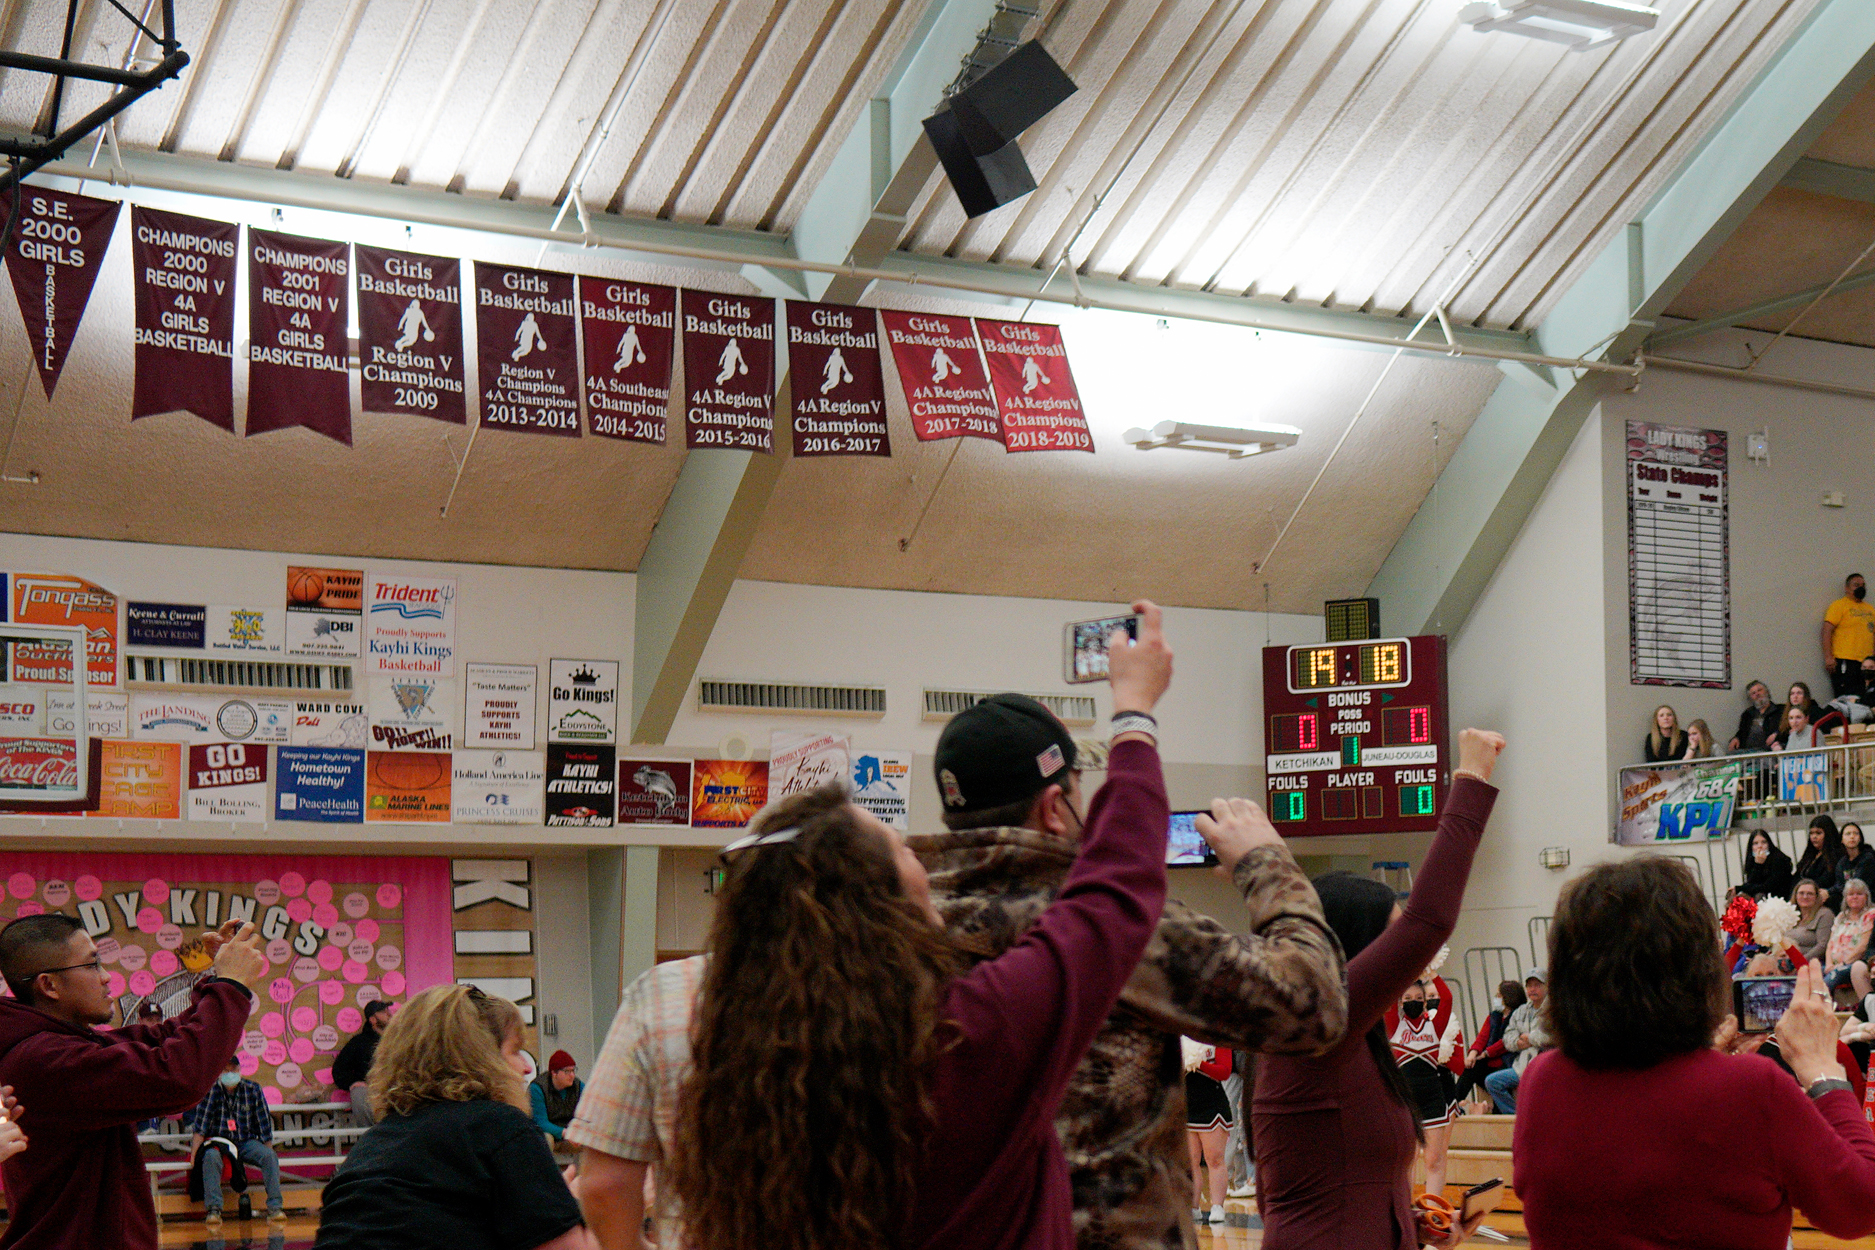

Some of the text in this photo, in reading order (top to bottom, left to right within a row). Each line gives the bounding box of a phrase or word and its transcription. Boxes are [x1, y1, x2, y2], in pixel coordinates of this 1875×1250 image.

[32, 197, 74, 221] S.E.
[22, 218, 81, 244] 2000
[138, 226, 234, 258] CHAMPIONS
[19, 240, 85, 267] GIRLS
[164, 251, 207, 273] 2000
[254, 247, 347, 275] CHAMPIONS
[385, 258, 433, 280] Girls
[146, 268, 225, 295] REGION V
[282, 272, 320, 291] 2001
[359, 273, 458, 304] Basketball
[503, 272, 549, 293] Girls
[174, 295, 196, 312] 4A
[263, 287, 338, 312] REGION V
[480, 288, 574, 317] Basketball
[45, 264, 55, 370] BASKETBALL
[161, 312, 209, 333] GIRLS
[290, 312, 311, 329] 4A
[812, 309, 853, 329] Girls
[278, 329, 324, 350] GIRLS
[790, 326, 877, 349] Basketball
[1001, 325, 1040, 341] Girls
[135, 328, 233, 358] BASKETBALL
[984, 339, 1065, 357] Basketball
[251, 346, 348, 373] BASKETBALL
[372, 346, 452, 372] Region V
[363, 365, 463, 393] Champions
[501, 363, 555, 380] Region V
[497, 376, 565, 394] Champions
[394, 388, 438, 410] 2009
[485, 390, 577, 409] 4A Champions
[797, 399, 881, 416] 4A Region V
[1004, 397, 1081, 411] 4A Region V
[487, 404, 578, 429] 2013-2014
[794, 417, 886, 435] Champions
[925, 418, 998, 434] 2017-2018
[1004, 413, 1087, 429] Champions
[595, 415, 665, 441] 2014-2015
[695, 430, 770, 449] 2015-2016
[803, 438, 881, 452] 2016-2017
[1008, 431, 1090, 448] 2018-2019
[326, 576, 360, 585] KAYHI
[15, 578, 115, 619] Tongass
[326, 589, 358, 599] PRIDE
[375, 583, 439, 602] Trident
[331, 621, 353, 632] DBI
[369, 640, 409, 658] Kayhi
[413, 641, 452, 660] Kings
[16, 665, 56, 680] Proud
[379, 659, 441, 672] Basketball
[485, 700, 517, 708] PROUDLY
[553, 687, 614, 703] Go Kings!
[1328, 692, 1371, 707] BONUS
[162, 705, 211, 724] LANDING
[297, 703, 330, 713] WARD
[336, 704, 363, 714] COVE
[482, 711, 520, 719] SUPPORTS
[1338, 709, 1362, 720] POSS
[53, 718, 74, 730] Go
[1299, 714, 1316, 749] 0
[1330, 721, 1371, 735] PERIOD
[1410, 707, 1428, 743] 0
[101, 744, 172, 760] FIRST
[206, 742, 246, 769] GO
[1363, 750, 1435, 762] JUNEAU-DOUGLAS
[105, 763, 163, 777] CITY
[290, 762, 351, 773] Hometown
[562, 764, 599, 778] KAYHI
[1275, 756, 1334, 770] KETCHIKAN
[197, 766, 260, 786] KINGS!
[297, 775, 344, 789] Healthy!
[1268, 776, 1308, 790] FOULS
[1328, 772, 1374, 787] PLAYER
[1395, 769, 1436, 784] FOULS
[548, 779, 613, 794] ATHLETICS!
[1695, 777, 1739, 799] 684
[300, 798, 359, 809] PeaceHealth
[1289, 791, 1304, 820] 0
[1418, 785, 1433, 814] 0
[170, 887, 325, 956] KINGS
